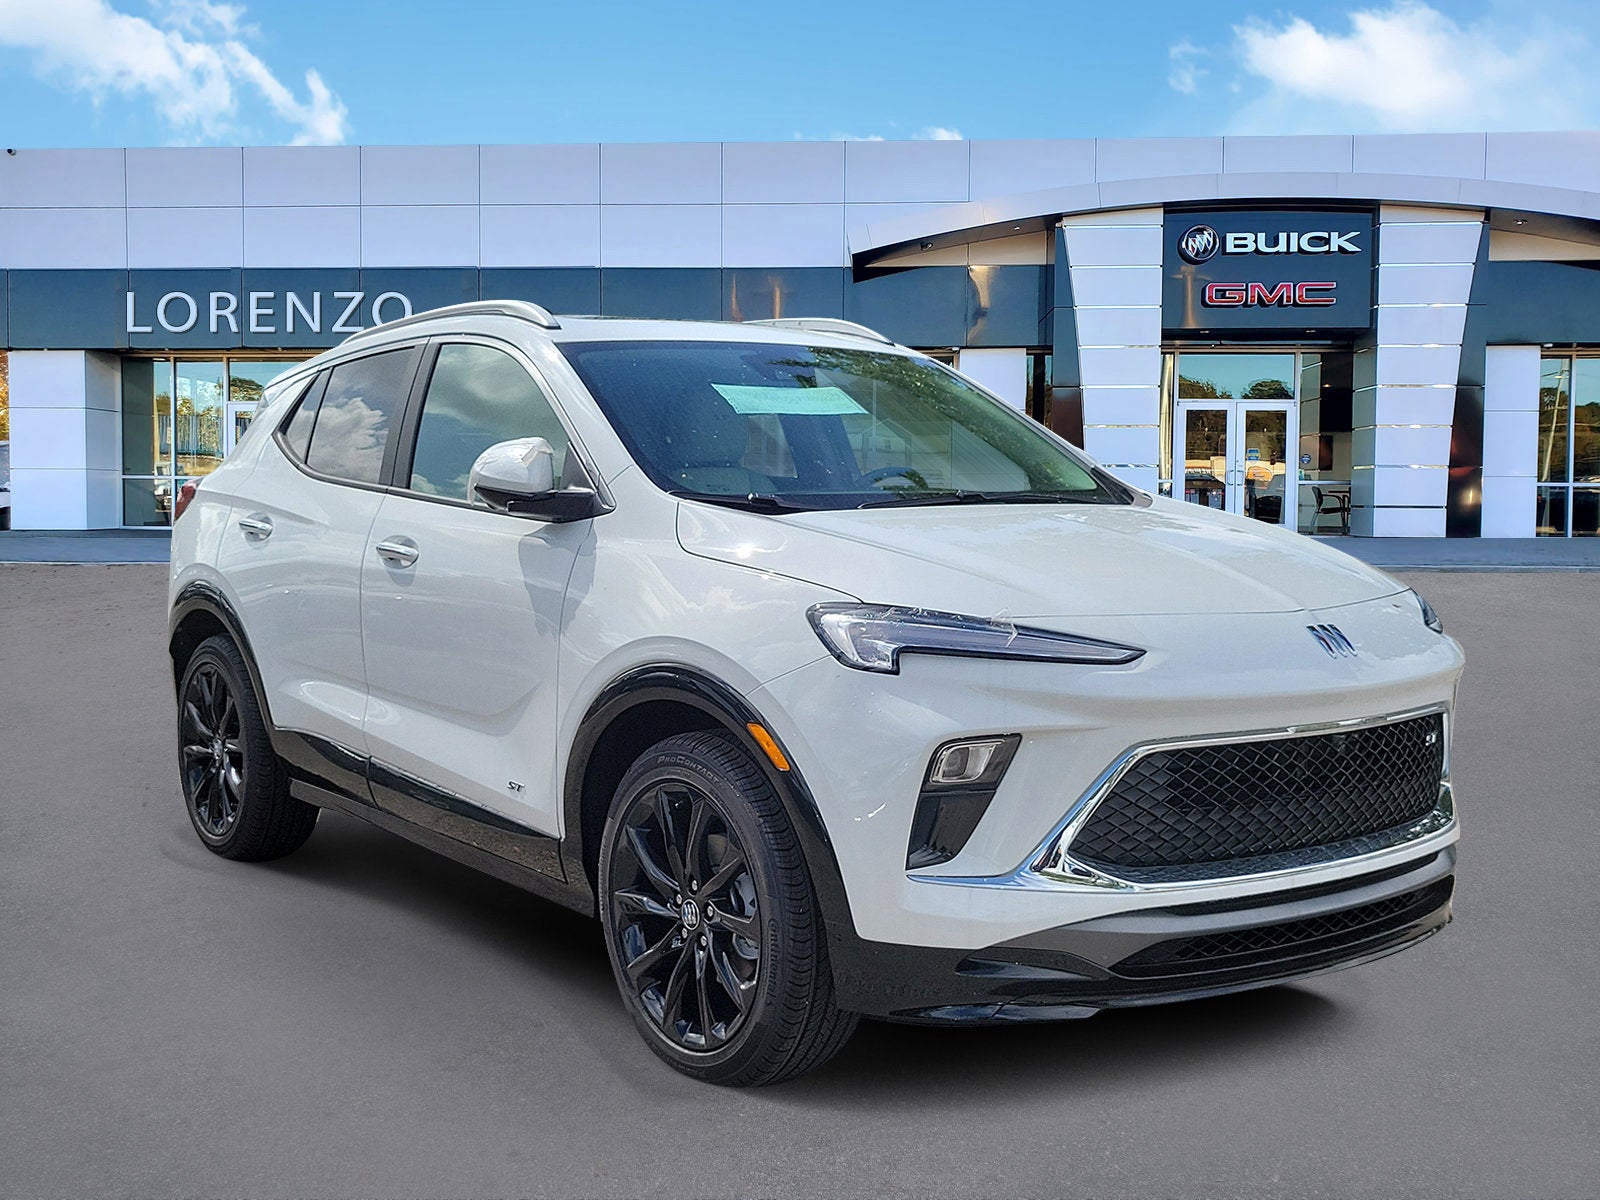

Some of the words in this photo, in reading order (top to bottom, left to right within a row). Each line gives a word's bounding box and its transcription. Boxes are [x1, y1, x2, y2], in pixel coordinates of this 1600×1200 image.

[1225, 231, 1362, 252] BUICK
[1204, 281, 1337, 305] GMC
[126, 291, 414, 333] LORENZO
[507, 780, 525, 791] ST
